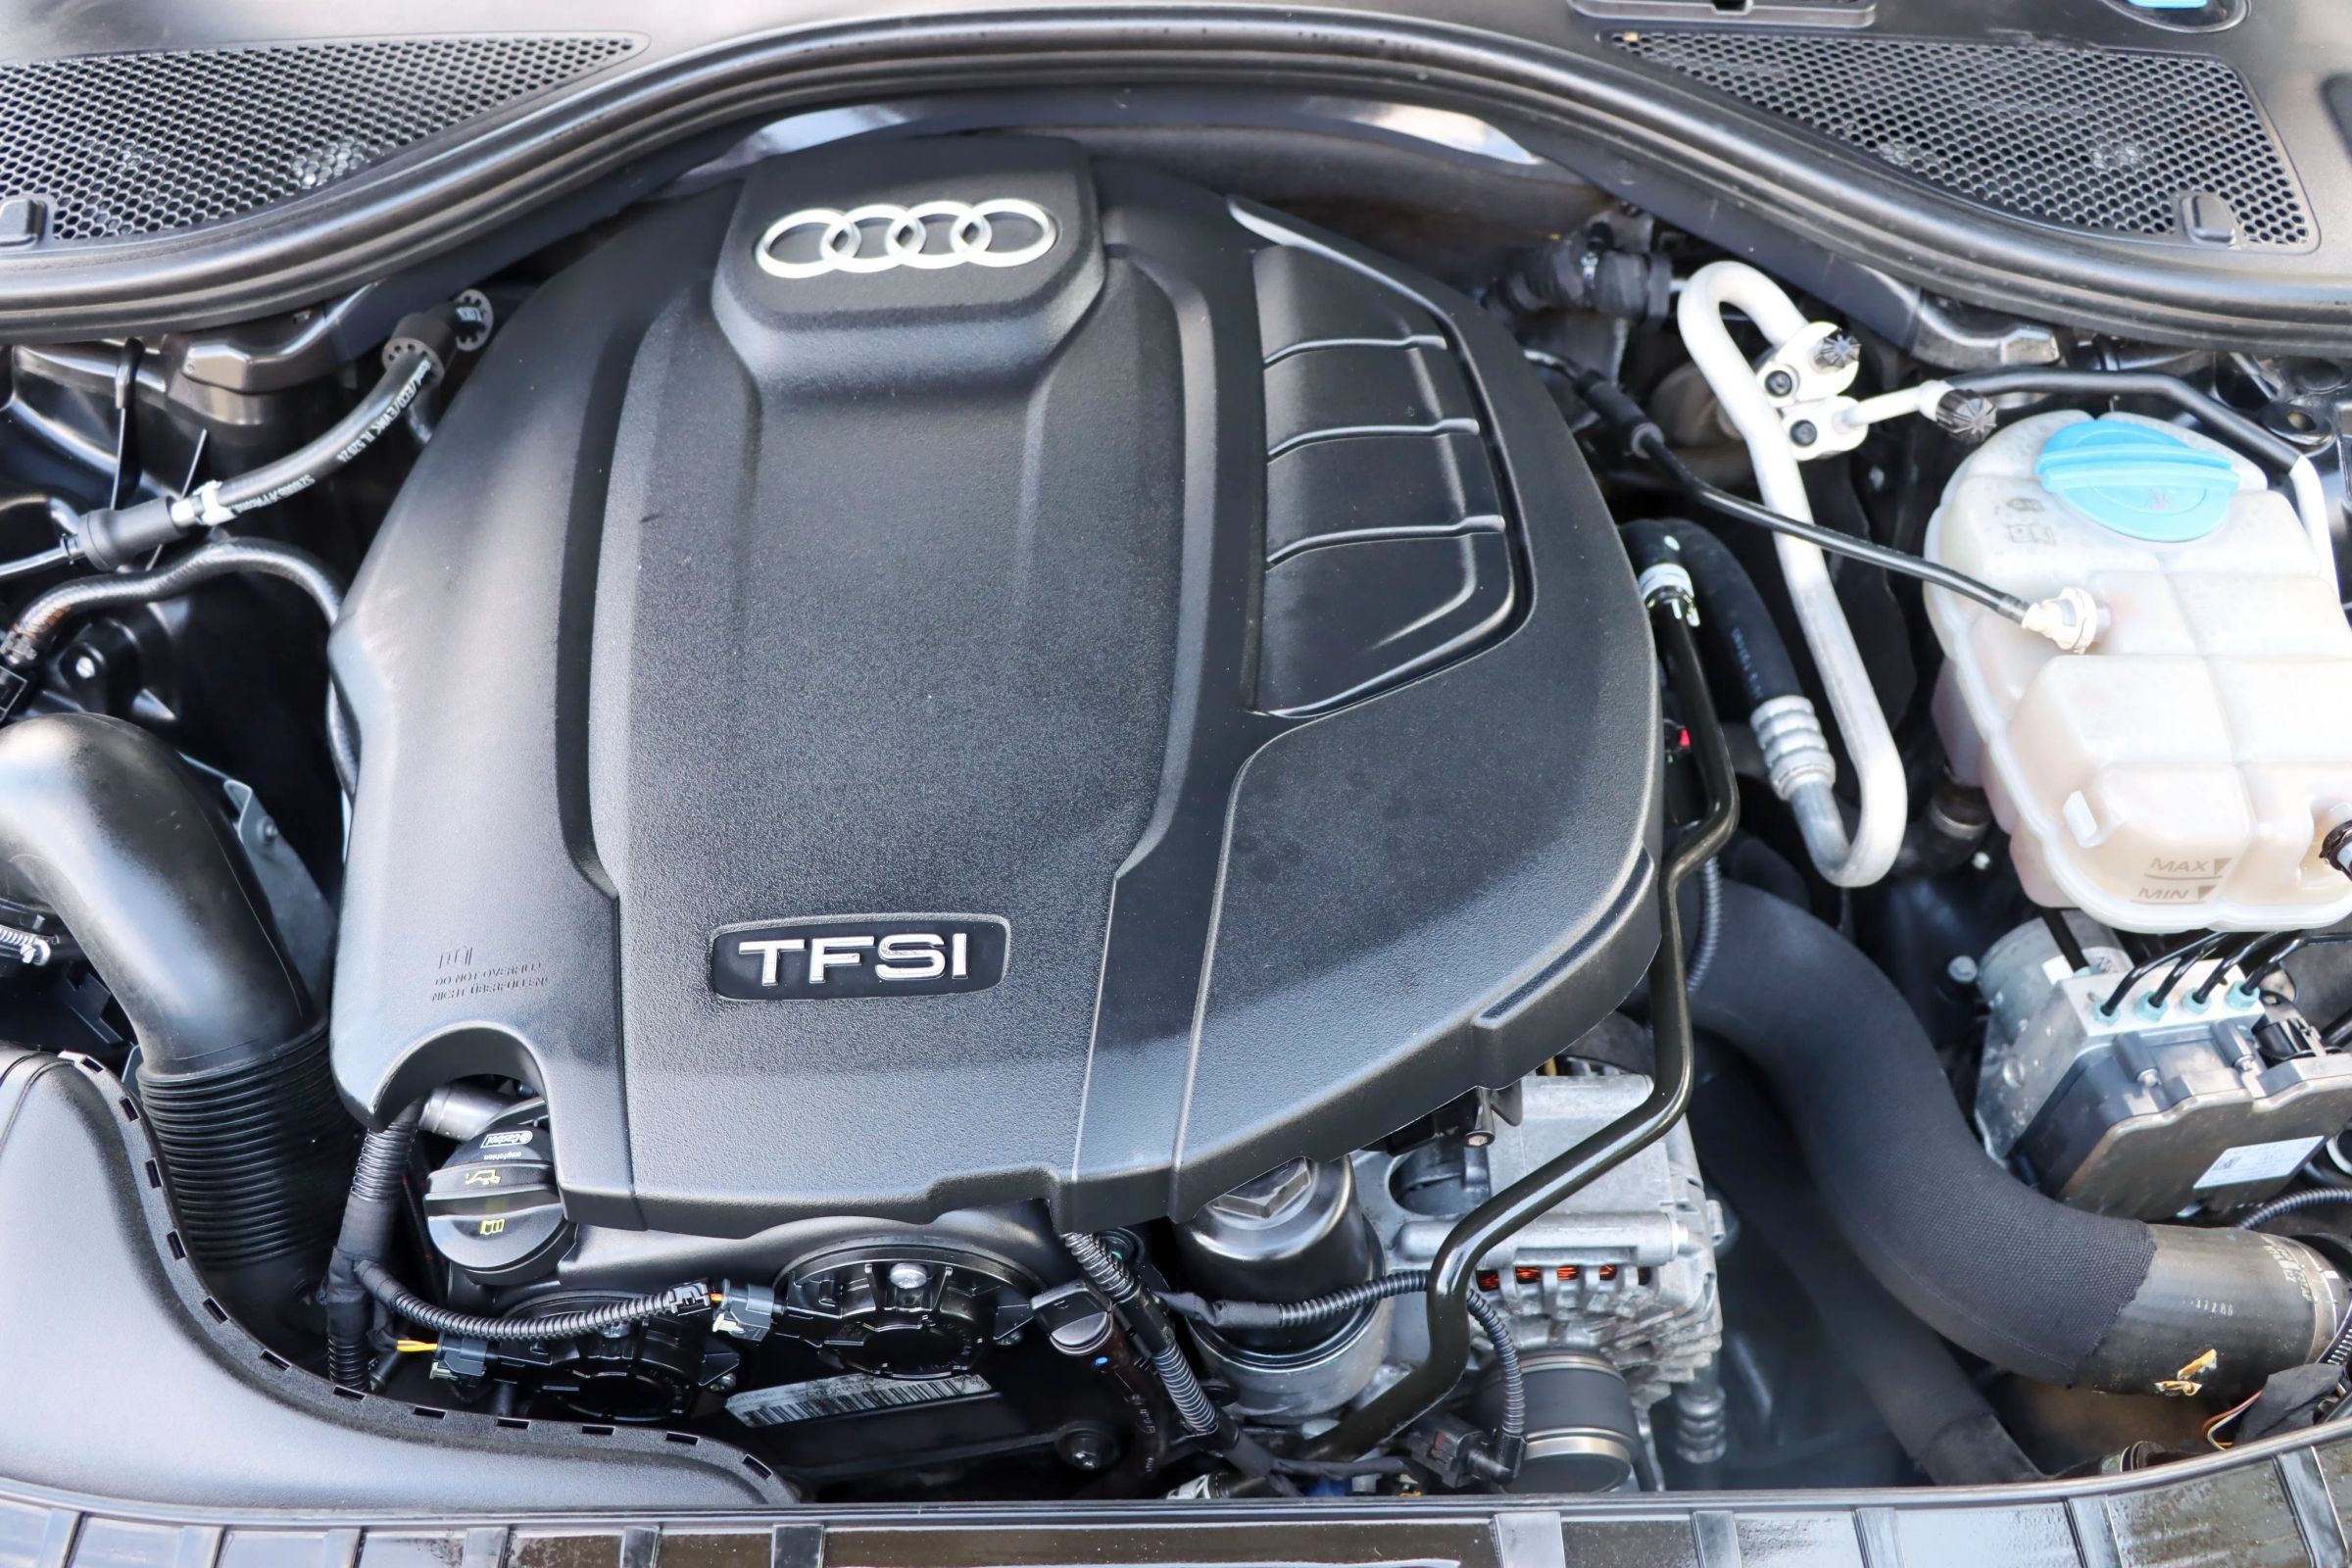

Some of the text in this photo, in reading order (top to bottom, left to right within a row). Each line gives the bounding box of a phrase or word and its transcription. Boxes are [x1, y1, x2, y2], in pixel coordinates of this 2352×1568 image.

[2149, 857, 2209, 872] MAX
[2137, 886, 2189, 900] MIN
[738, 933, 969, 986] TFSI
[435, 976, 452, 986] DO
[455, 972, 477, 983] NOT
[486, 1133, 520, 1146] Castrol
